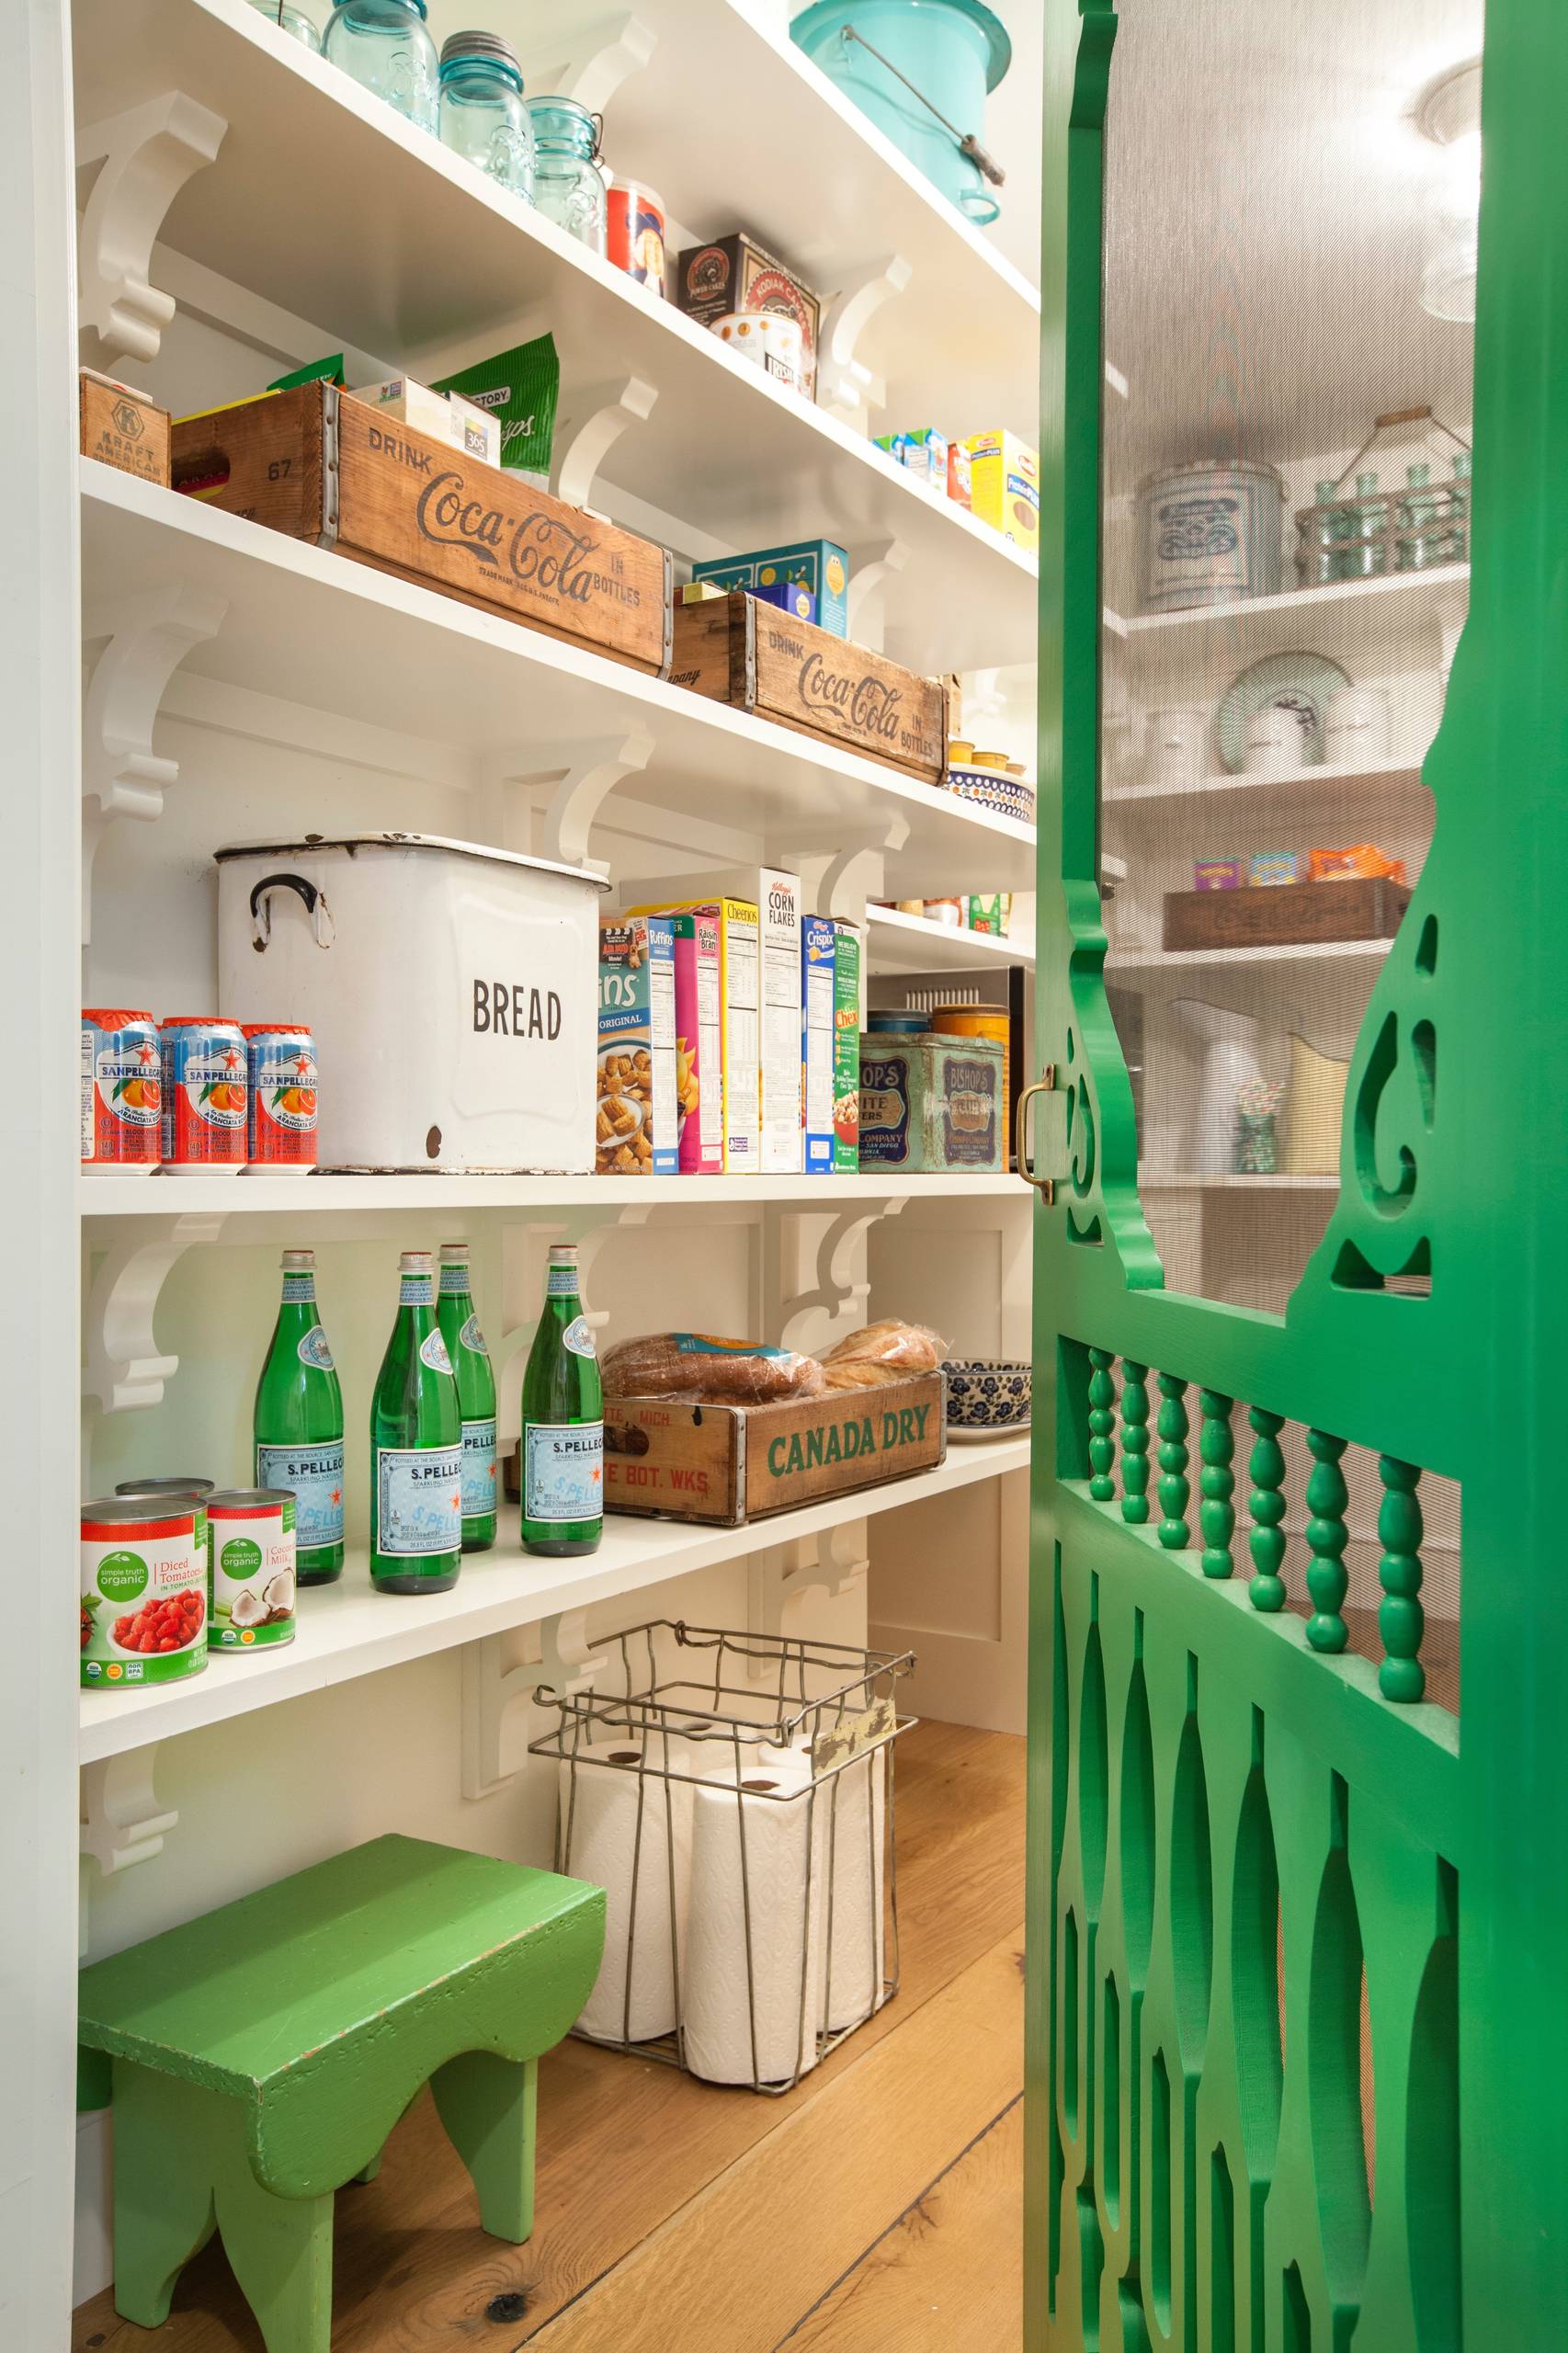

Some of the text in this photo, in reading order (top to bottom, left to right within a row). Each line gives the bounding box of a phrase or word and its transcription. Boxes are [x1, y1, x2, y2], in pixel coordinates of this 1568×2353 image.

[756, 278, 785, 299] KODIAK
[103, 430, 154, 460] KRAFT
[369, 427, 433, 475] DRINK
[468, 433, 485, 452] 365
[96, 442, 161, 475] AMERICAN
[268, 460, 291, 482] 67
[594, 573, 641, 607] BOTTLES
[769, 631, 804, 662] DRINK
[912, 713, 923, 731] IN
[901, 731, 934, 756] BOTTLES
[768, 892, 795, 913] CORN
[727, 904, 757, 923] Cheerios
[769, 909, 795, 927] FLAKES
[649, 929, 674, 947] Puffins
[699, 928, 717, 941] Raisin
[700, 938, 716, 949] Bran
[807, 931, 835, 949] Crispix
[473, 979, 562, 1040] BREAD
[598, 1015, 642, 1029] ORIGINAL
[835, 1010, 858, 1029] Chex
[640, 1411, 671, 1426] MICH
[767, 1403, 931, 1478] CANADA DRY
[626, 1465, 664, 1488] BOT.
[670, 1470, 709, 1494] WKS
[160, 1559, 189, 1573] Diced
[223, 1557, 259, 1567] organic
[101, 1567, 145, 1577] simple truth
[101, 1574, 145, 1587] organic
[170, 1581, 194, 1590] TOMATO
